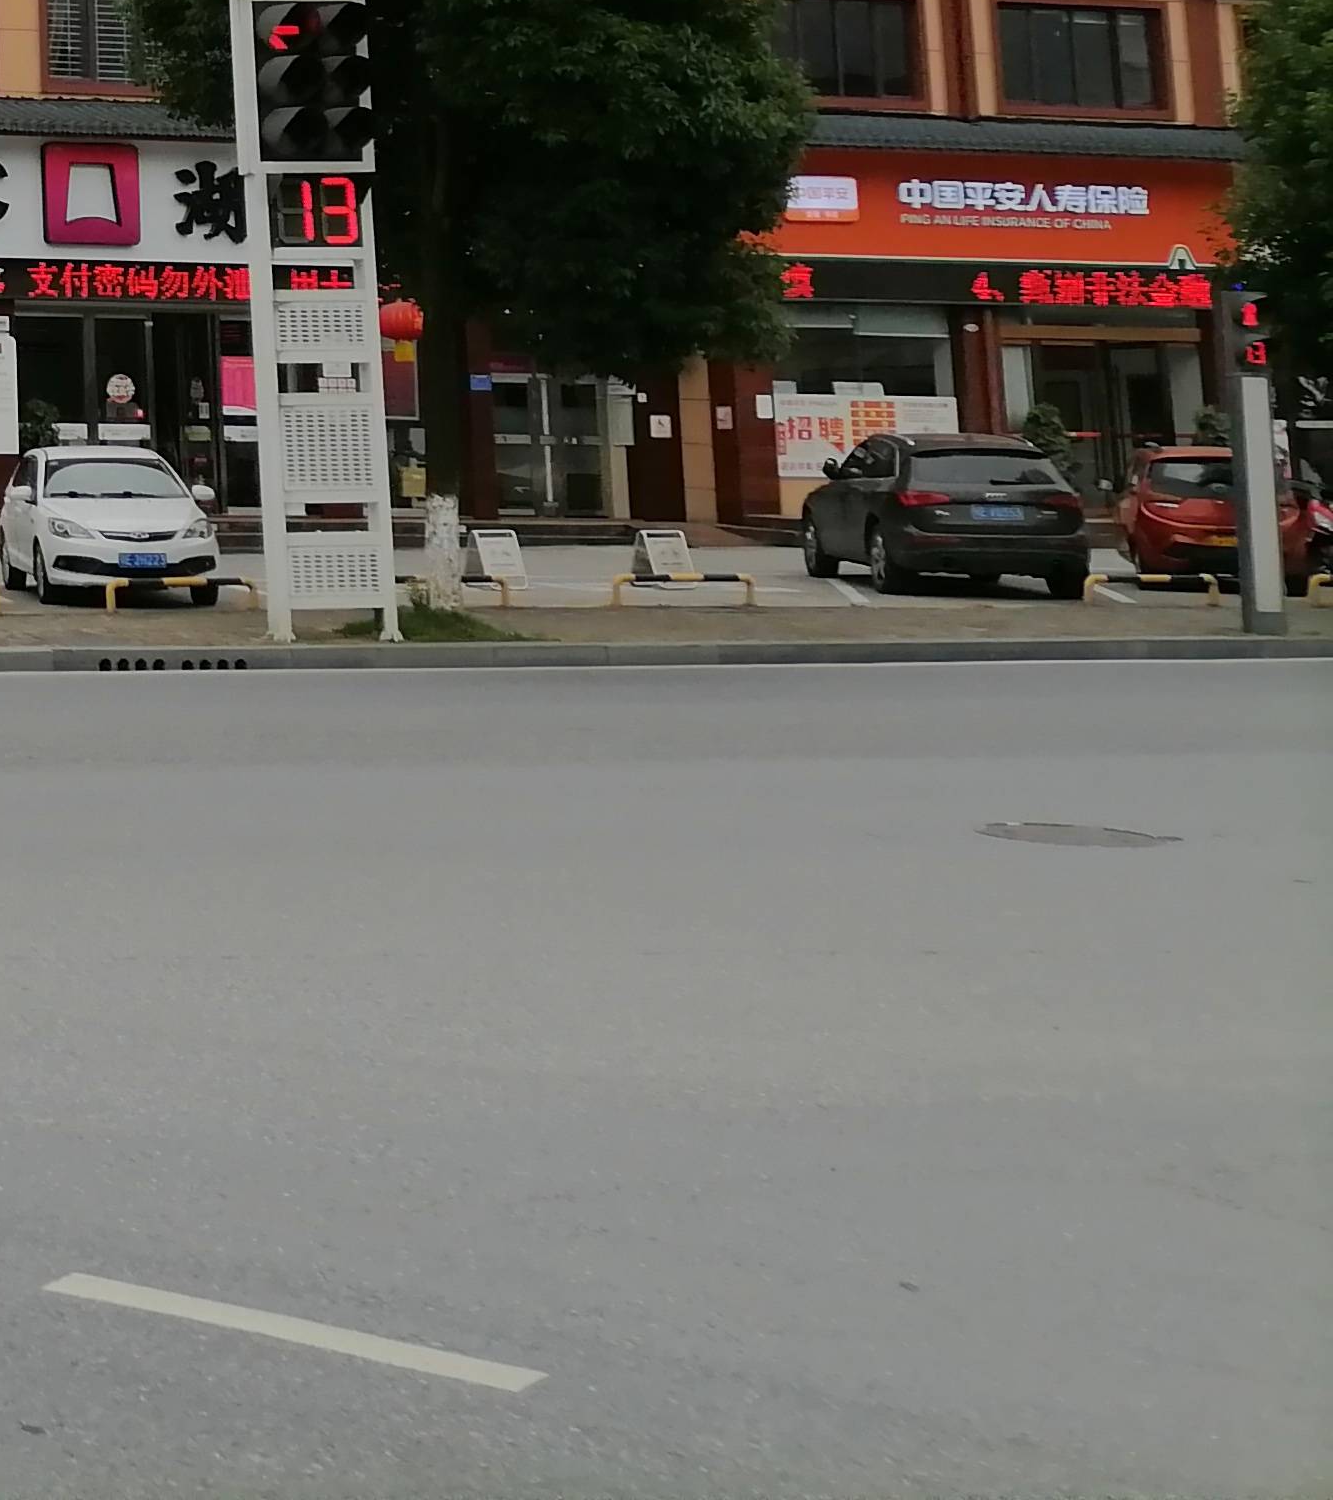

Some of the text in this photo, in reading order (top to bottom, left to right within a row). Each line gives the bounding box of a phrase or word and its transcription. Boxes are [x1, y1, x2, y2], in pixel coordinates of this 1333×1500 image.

[300, 177, 359, 245] 13
[898, 178, 1150, 215] 中国平安人寿保险
[900, 213, 1112, 230] PING AN LIFE INSURANCE OF CHINA
